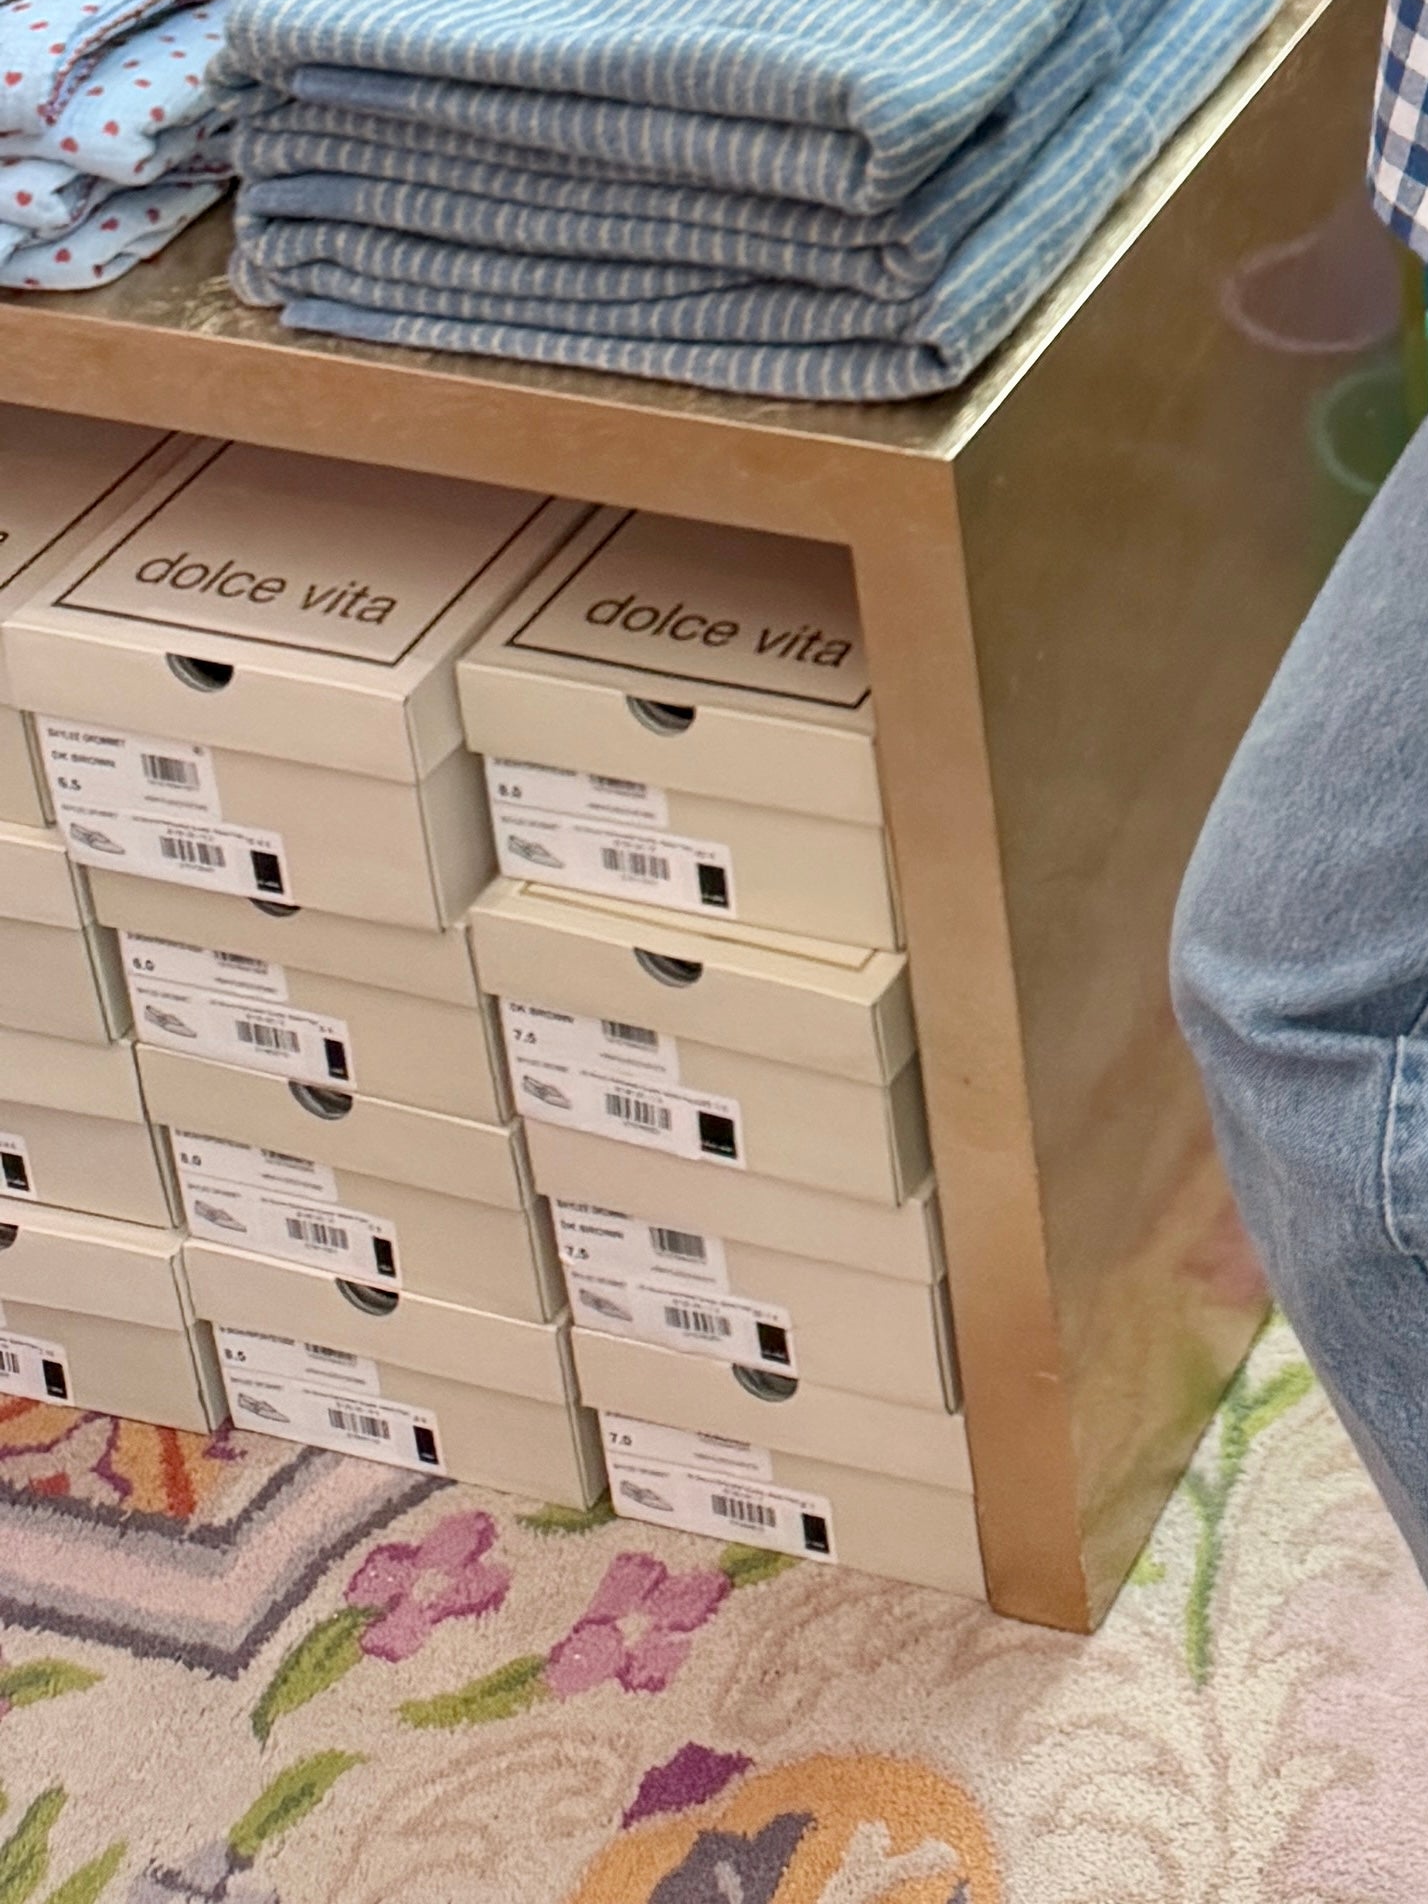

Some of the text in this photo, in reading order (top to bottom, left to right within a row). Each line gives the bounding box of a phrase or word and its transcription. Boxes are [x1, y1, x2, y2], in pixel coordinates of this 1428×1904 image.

[134, 552, 398, 626] dolce vita
[584, 595, 854, 670] dolce vita
